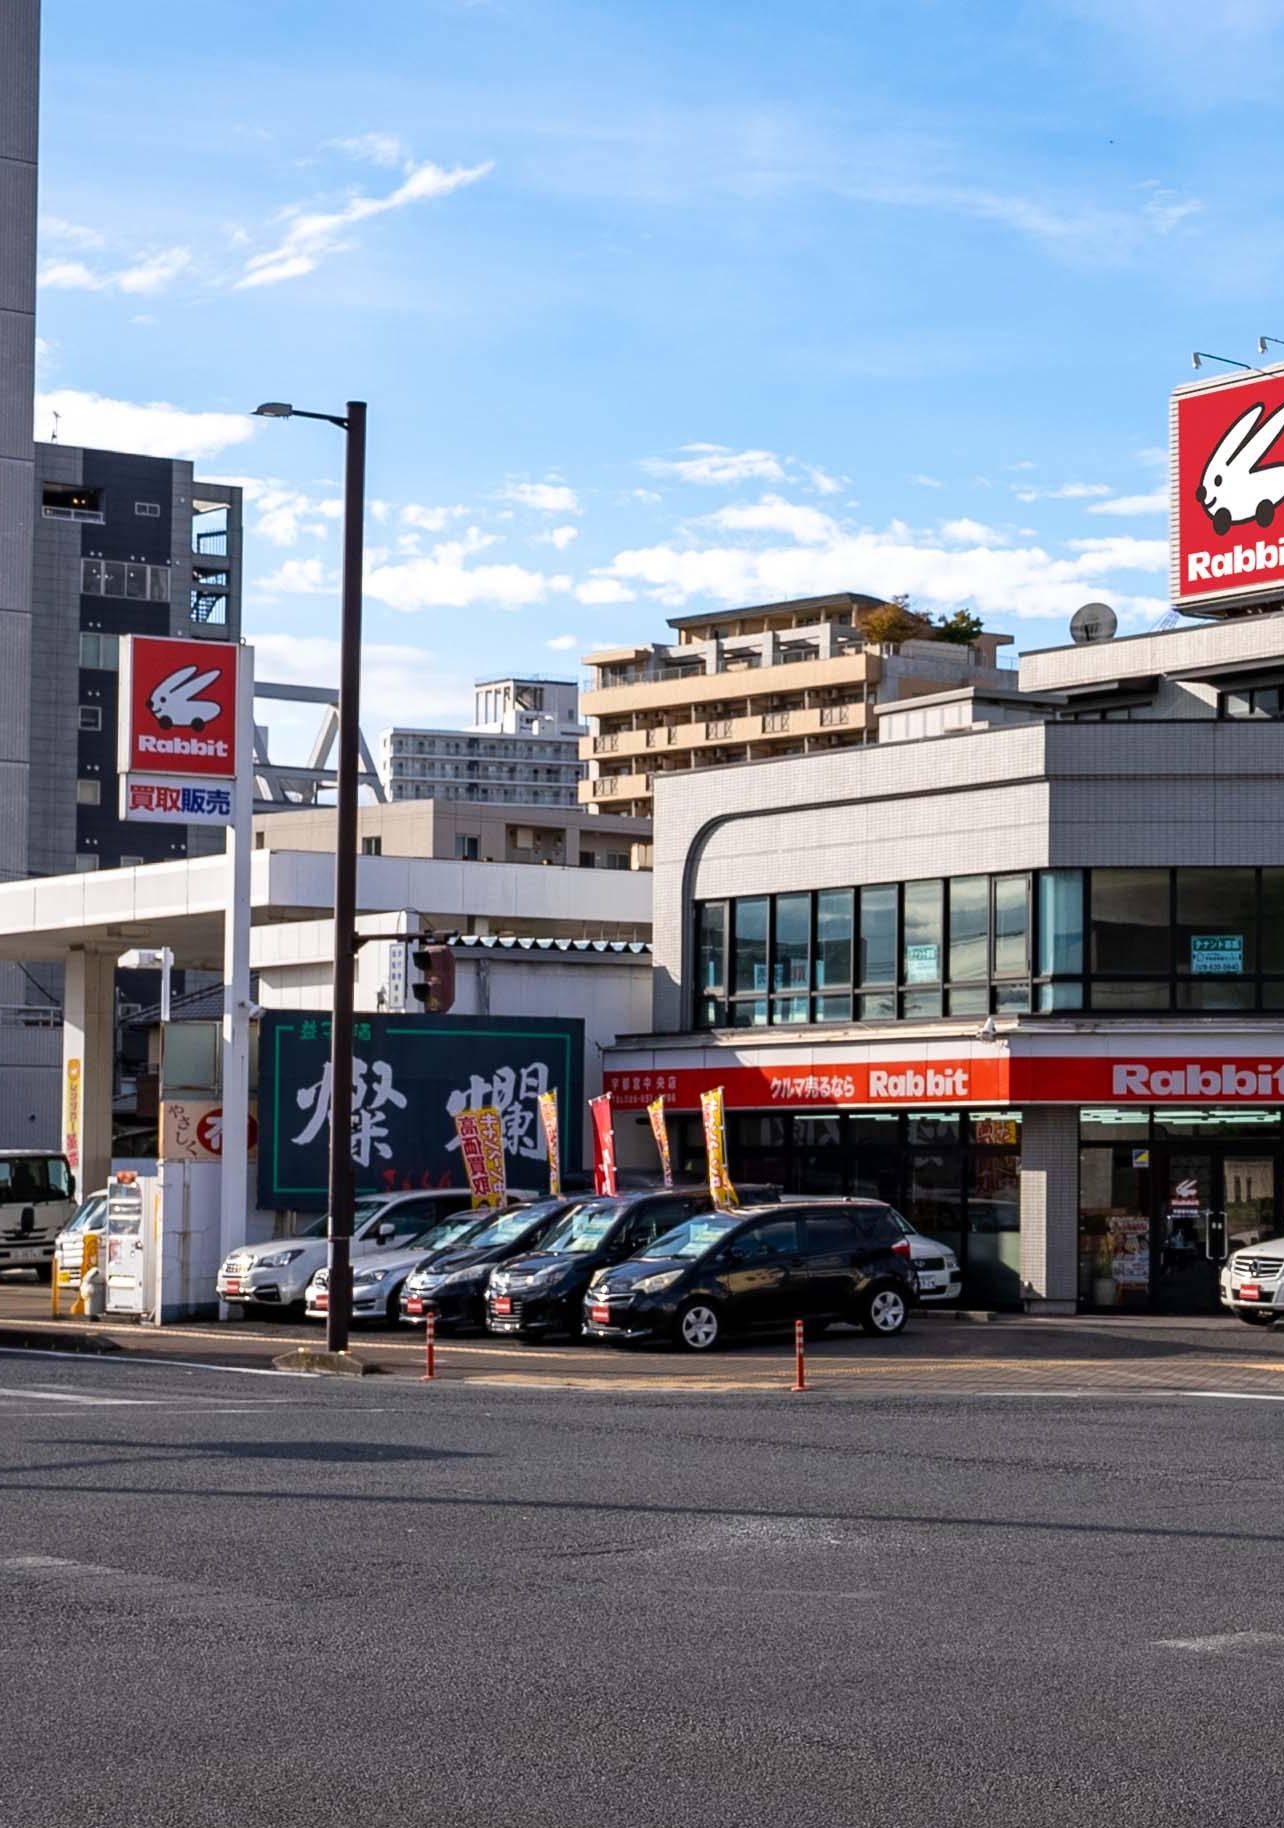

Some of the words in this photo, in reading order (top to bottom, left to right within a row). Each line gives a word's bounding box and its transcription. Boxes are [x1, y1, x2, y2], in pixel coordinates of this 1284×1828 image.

[138, 734, 228, 757] Rabbit
[130, 784, 231, 816] 買取販売
[770, 1076, 855, 1098] クルマ売るなら
[869, 1068, 968, 1097] Rabbit
